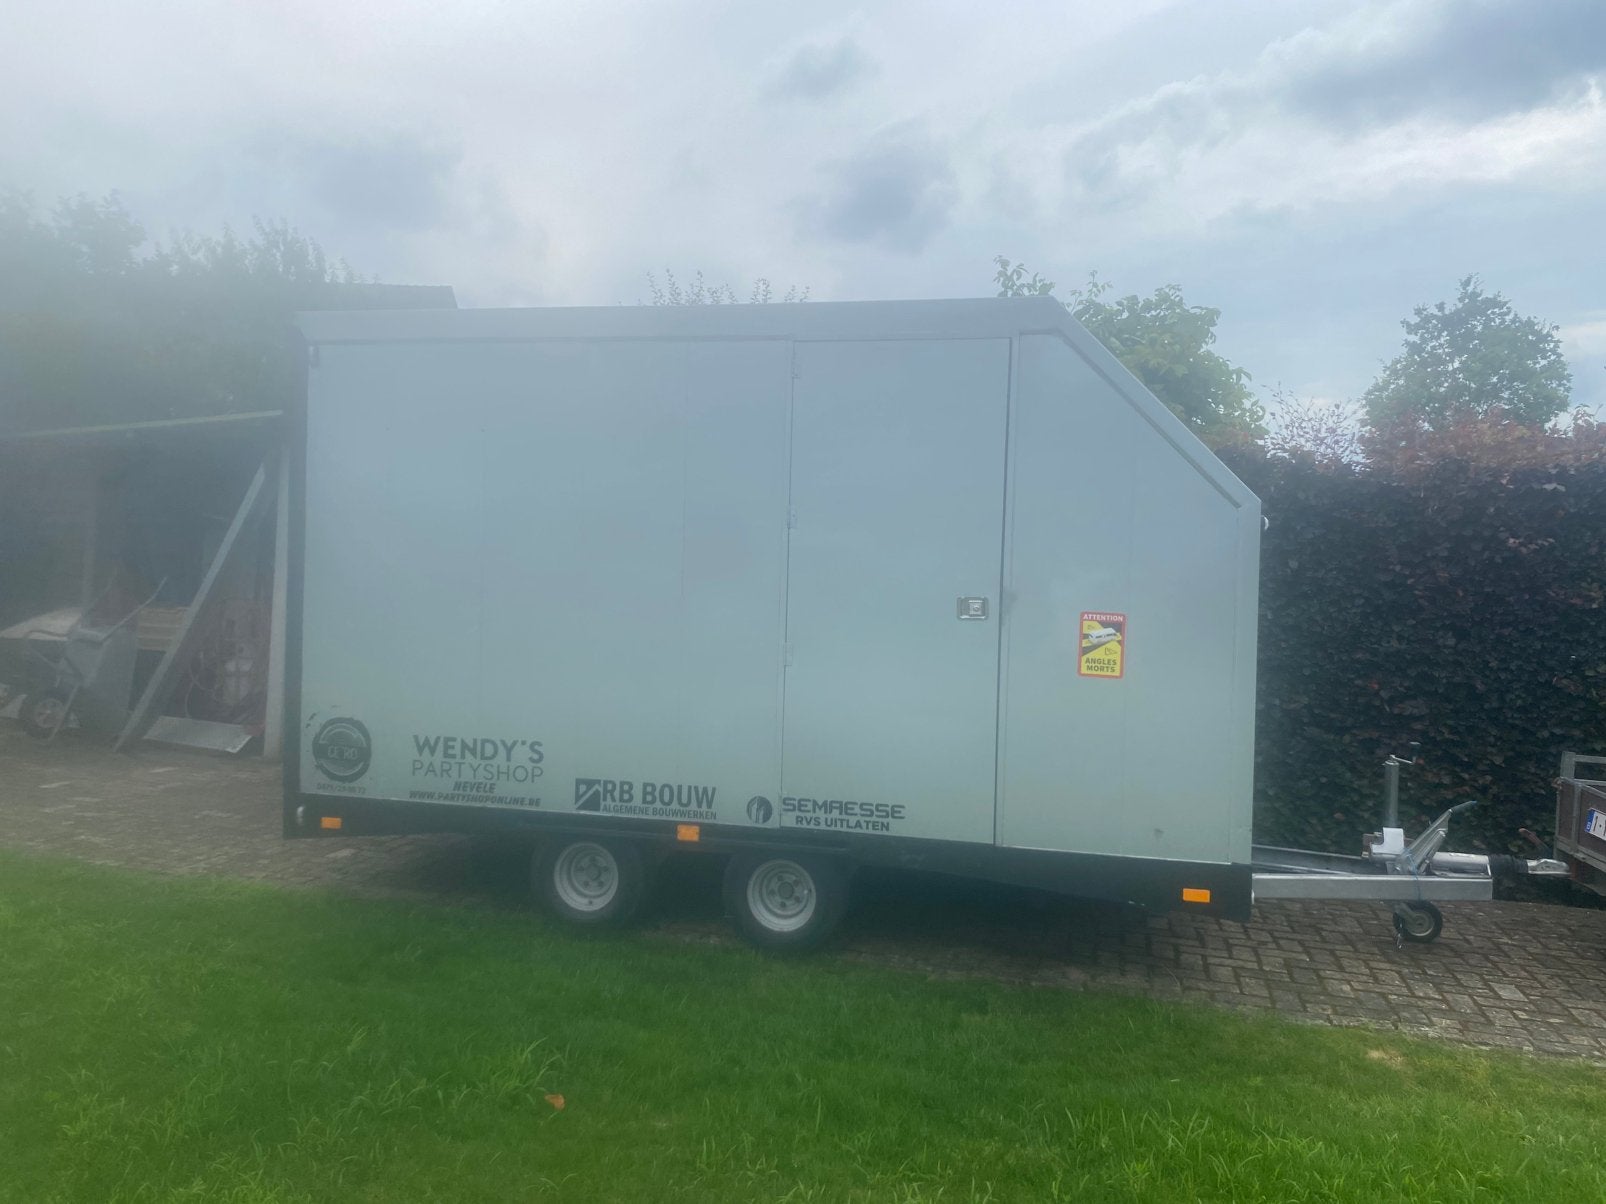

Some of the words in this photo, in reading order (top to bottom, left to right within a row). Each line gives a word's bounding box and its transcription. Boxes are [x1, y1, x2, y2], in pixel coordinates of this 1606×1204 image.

[1085, 658, 1117, 666] ANGLES
[1086, 665, 1116, 673] MORTS
[412, 734, 544, 764] WENDY'S
[411, 760, 544, 783] PARTYSHOP
[452, 781, 497, 794] NEVELE
[602, 779, 635, 804] RB
[641, 781, 717, 810] BOUW
[602, 803, 650, 816] ALGEMENE
[651, 806, 718, 821] BOUWWERKEN
[795, 815, 822, 828] RVS
[824, 816, 890, 832] UITLATEN
